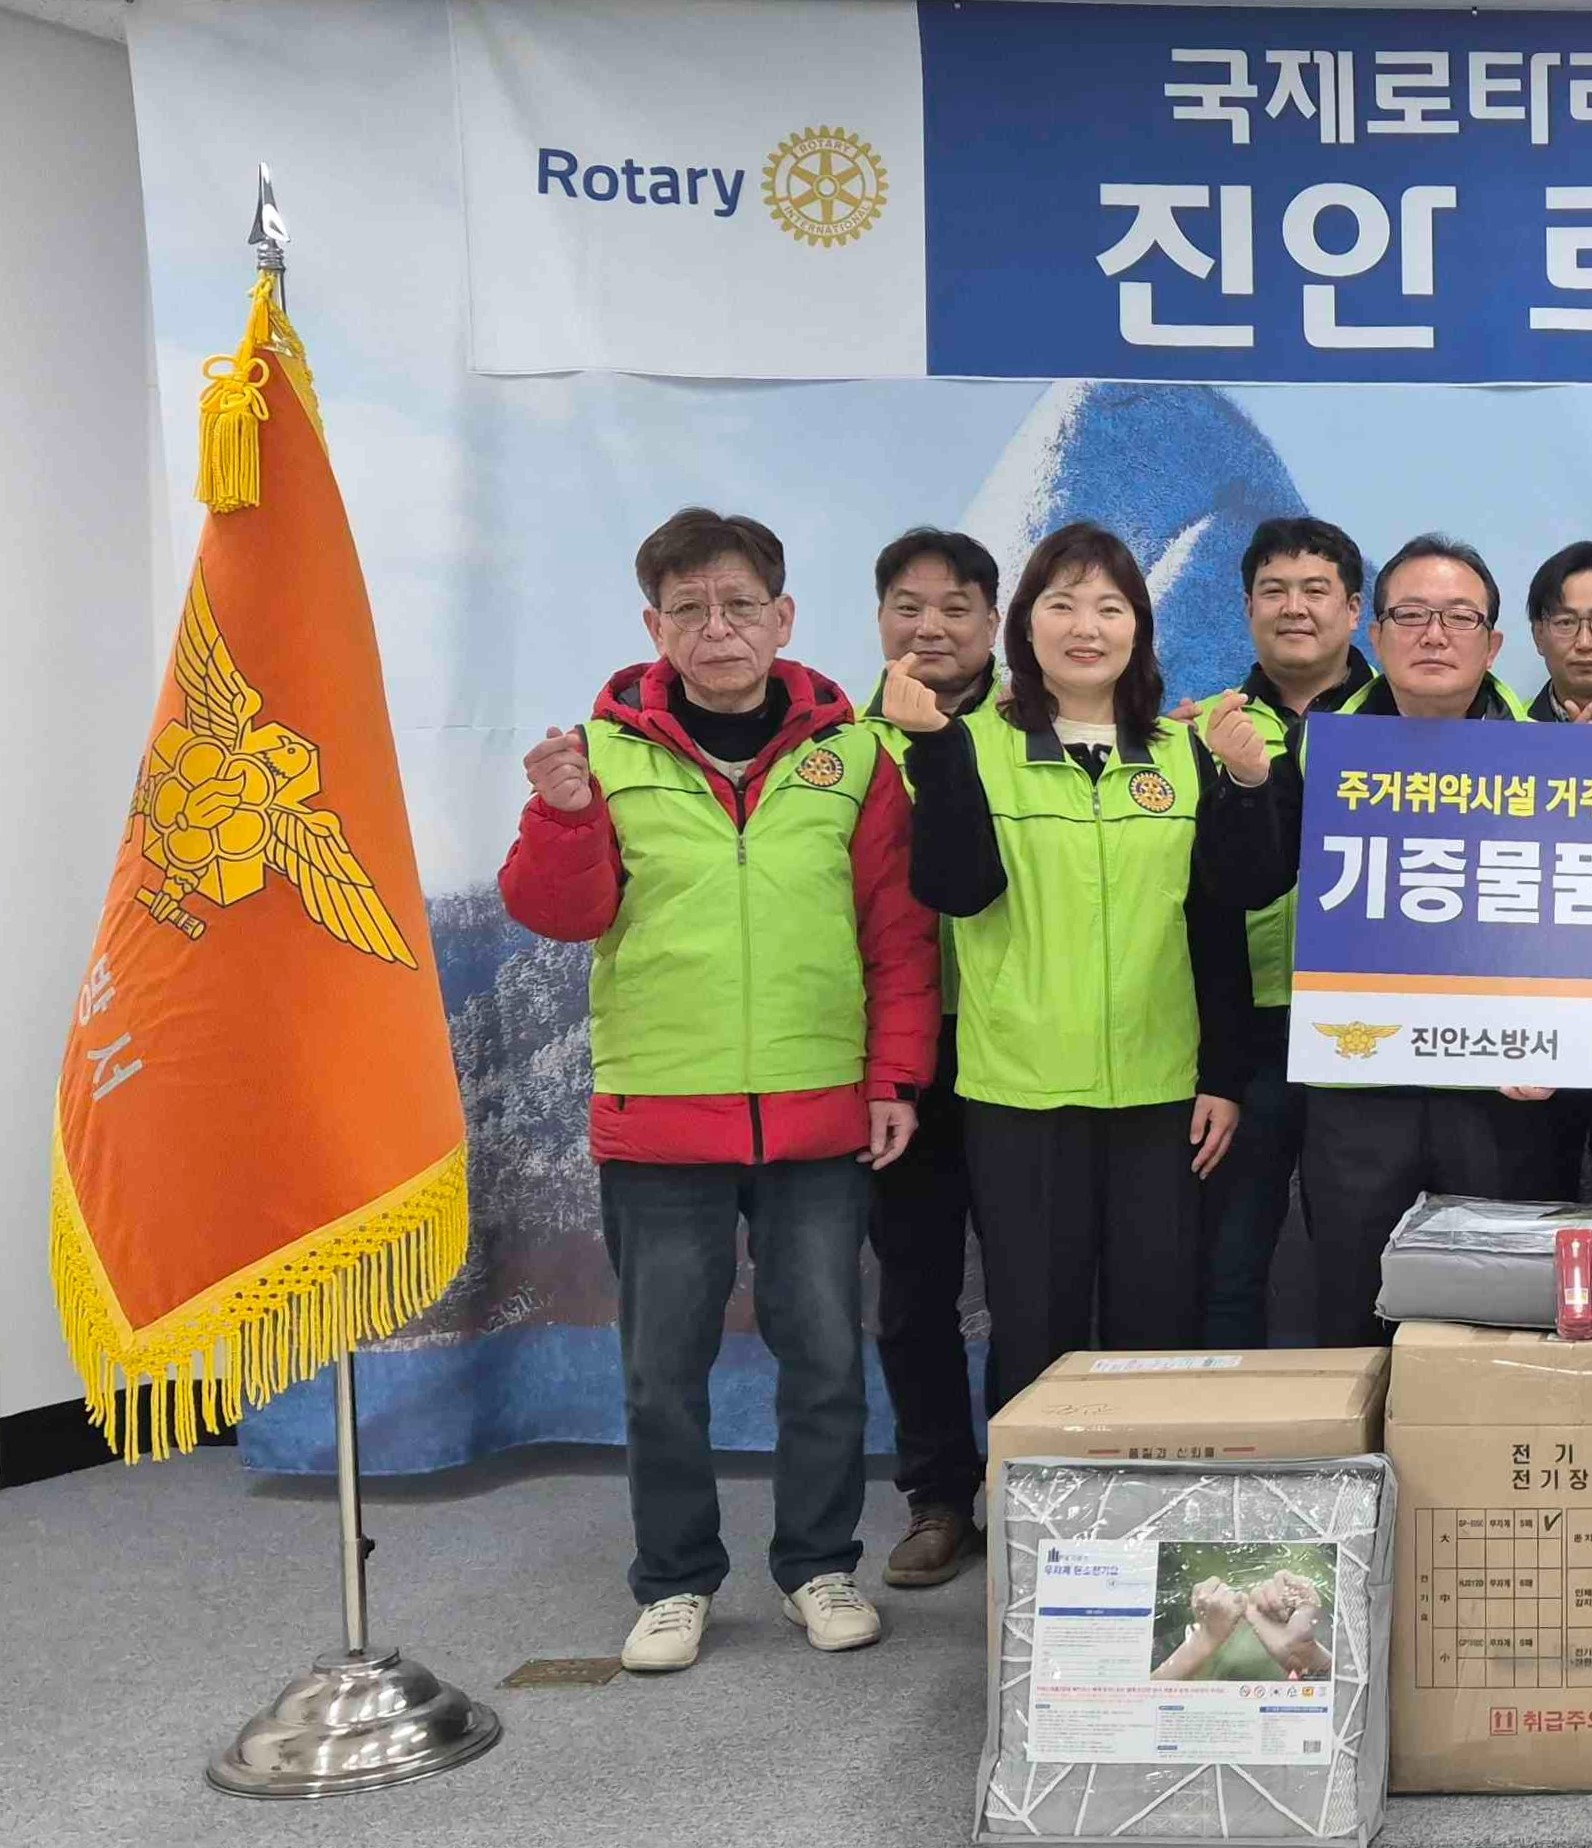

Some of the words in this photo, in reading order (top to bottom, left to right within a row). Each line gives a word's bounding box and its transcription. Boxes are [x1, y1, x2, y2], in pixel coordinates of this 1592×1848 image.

[800, 139, 850, 153] ROTARY
[537, 148, 745, 218] Rotary
[783, 205, 871, 234] INTERNATIONAL
[1095, 184, 1458, 350] 진안
[1336, 770, 1535, 817] 주거취약시설
[1411, 1026, 1560, 1062] 진안소방서
[1439, 1534, 1450, 1544] 大
[1440, 1594, 1451, 1604] 中
[1440, 1652, 1450, 1664] 小
